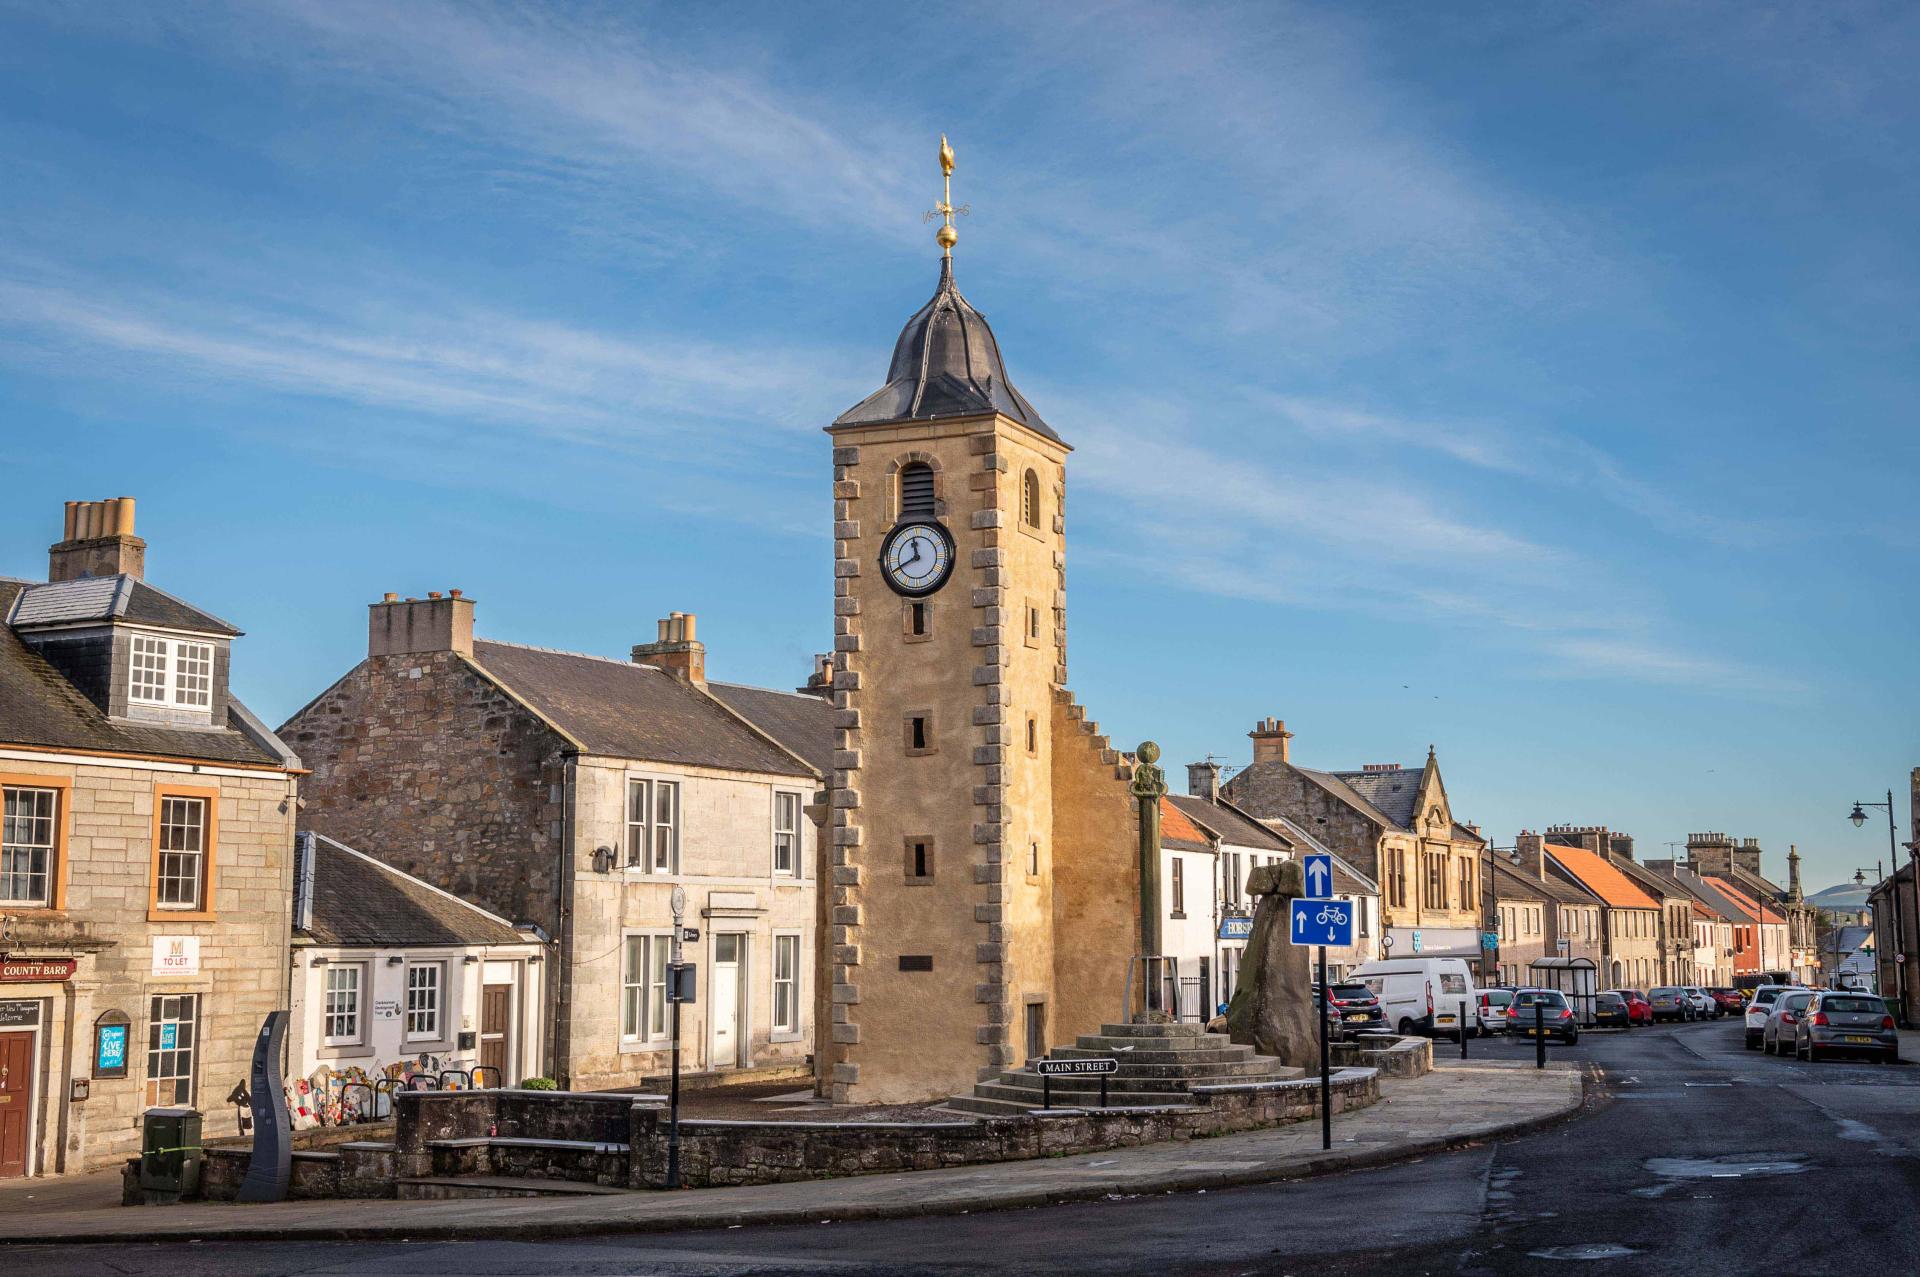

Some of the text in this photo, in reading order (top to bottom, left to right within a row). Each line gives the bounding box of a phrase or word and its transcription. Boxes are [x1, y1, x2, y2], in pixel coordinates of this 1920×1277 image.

[163, 957, 188, 966] TO LET
[3, 966, 67, 976] COUNTY BARR
[103, 1040, 121, 1050] LIVE
[1045, 1062, 1110, 1072] MAIN STREET
